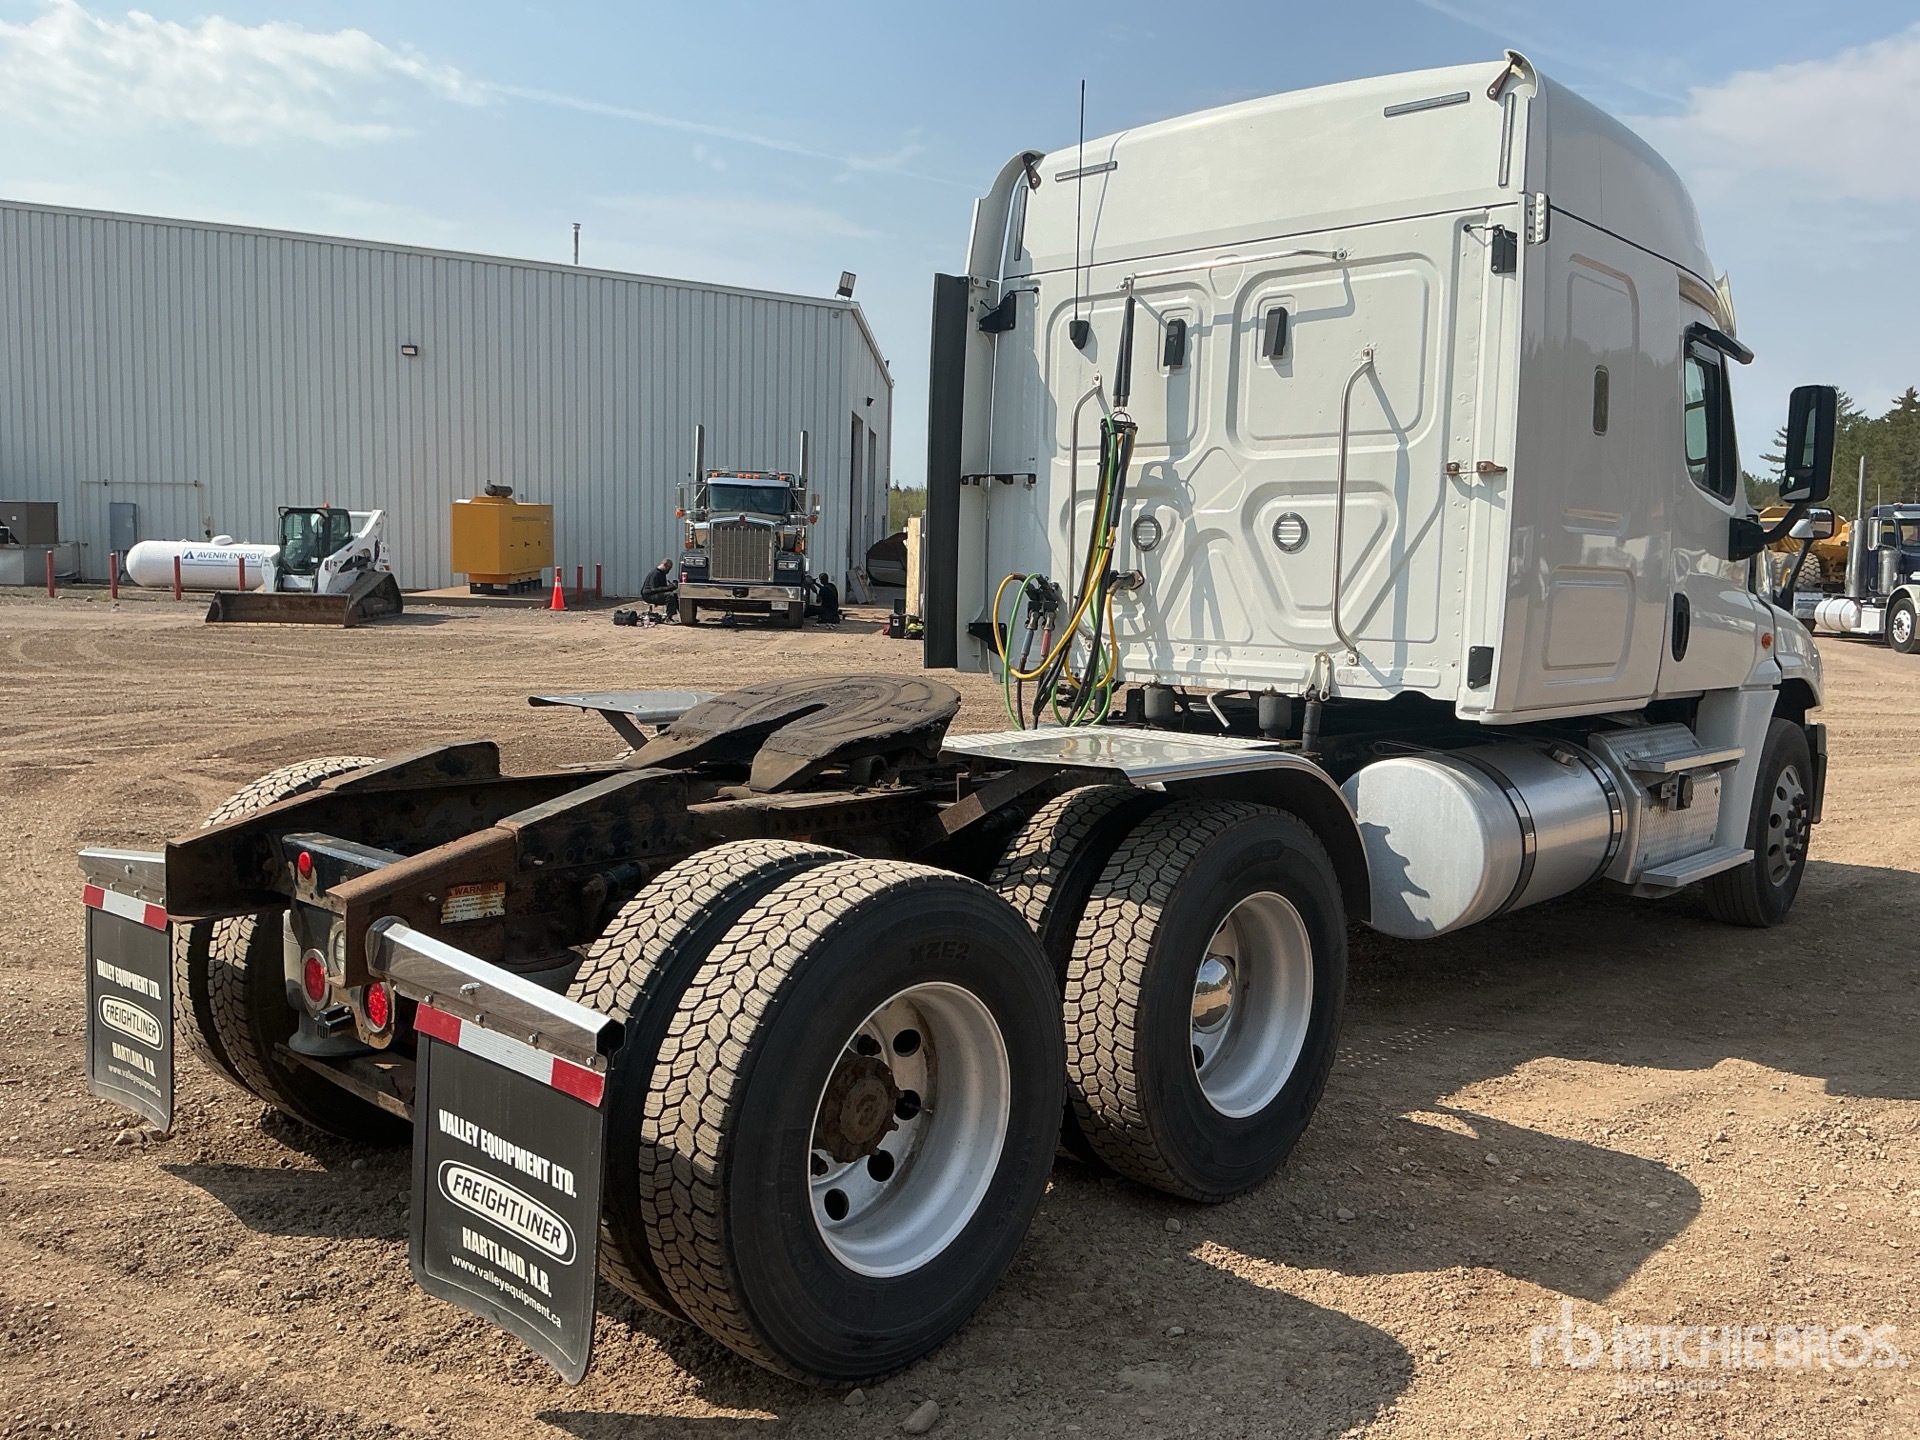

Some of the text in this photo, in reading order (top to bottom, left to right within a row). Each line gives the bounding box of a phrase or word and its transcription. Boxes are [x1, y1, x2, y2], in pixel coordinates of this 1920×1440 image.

[196, 551, 262, 560] AVENIR ENERGY
[909, 941, 971, 965] XZE2
[106, 1004, 157, 1040] FREIGHTLINER
[438, 1108, 577, 1198] VALLEY EQUIPMENT LTD.
[452, 1174, 561, 1249] FREIGHTLINER
[451, 1254, 561, 1329] www.valleyequipment.ca
[461, 1226, 552, 1297] HARTLAND, N.B.
